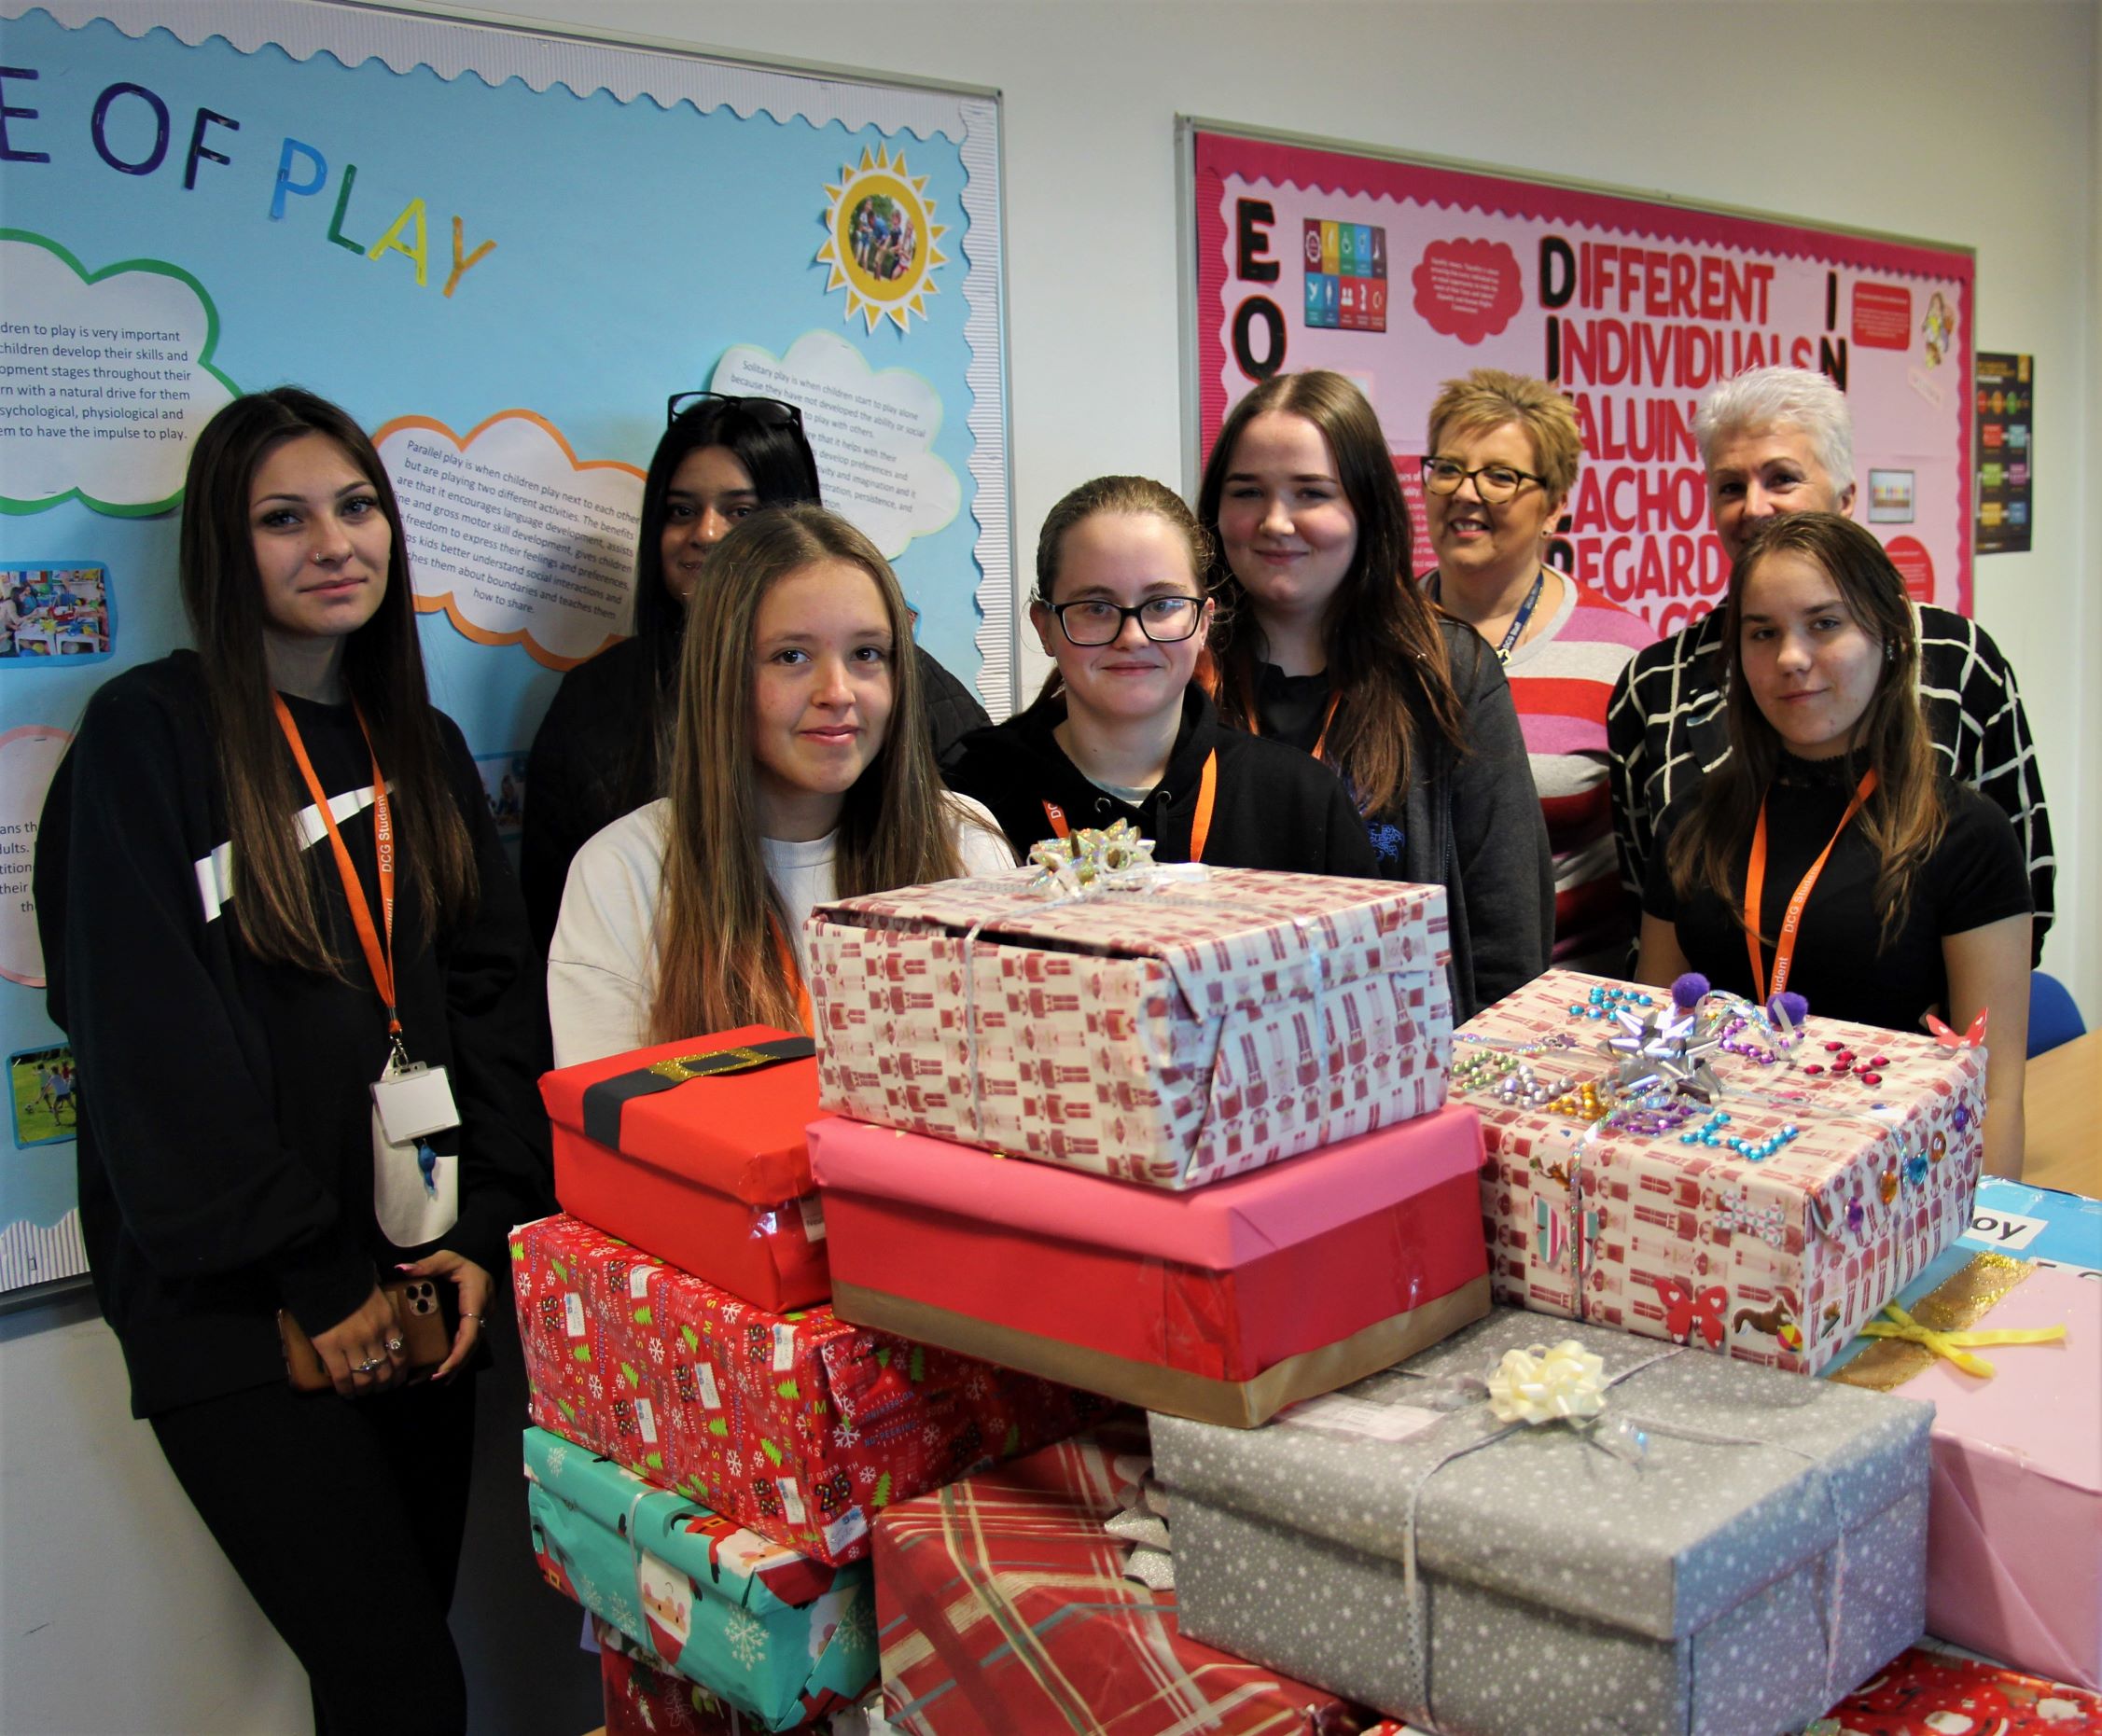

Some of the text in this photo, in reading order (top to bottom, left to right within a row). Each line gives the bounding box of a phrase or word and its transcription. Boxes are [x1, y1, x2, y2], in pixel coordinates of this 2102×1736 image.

[90, 82, 240, 190] OF
[270, 137, 497, 298] PLAY
[1539, 234, 1775, 326] DIFFERENT
[1, 322, 180, 342] dren to play is very important
[52, 344, 101, 360] develop
[104, 347, 132, 359] their
[136, 349, 164, 361] skills
[167, 351, 188, 362] and
[17, 384, 46, 396] with
[49, 388, 56, 396] a
[60, 385, 103, 398] natural
[106, 387, 137, 399] drive
[140, 388, 157, 399] for
[160, 389, 190, 400] them
[51, 367, 90, 379] stages
[93, 368, 162, 381] throughout
[164, 370, 191, 381] their
[20, 425, 188, 441] to have the impulse to play.
[82, 406, 159, 421] physiological
[161, 408, 184, 419] and
[1562, 392, 1698, 462] ALUIN
[404, 458, 633, 540] but are playing two different activities. The benefits
[407, 440, 640, 523] Parallel play is when children play next to each other
[1557, 465, 1716, 534] ACHO
[397, 477, 633, 557] are that it encourages language development, assists
[412, 500, 632, 572] and gross motor skill development, gives children
[405, 514, 447, 534] freedom
[450, 528, 460, 537] to
[462, 534, 496, 549] express
[500, 543, 521, 556] their
[523, 549, 558, 568] feelings
[560, 562, 576, 573] and
[578, 568, 628, 590] preferences,
[419, 536, 622, 604] kids better understand social interactions and
[431, 559, 615, 618] them about boundaries and teaches them
[473, 588, 534, 613] how to share.
[377, 795, 392, 873] DCG Student
[1784, 865, 1819, 933] DCG Student
[1971, 1216, 2027, 1241] oy
[814, 1470, 852, 1512] 25
[816, 1462, 859, 1481] OPEN TH
